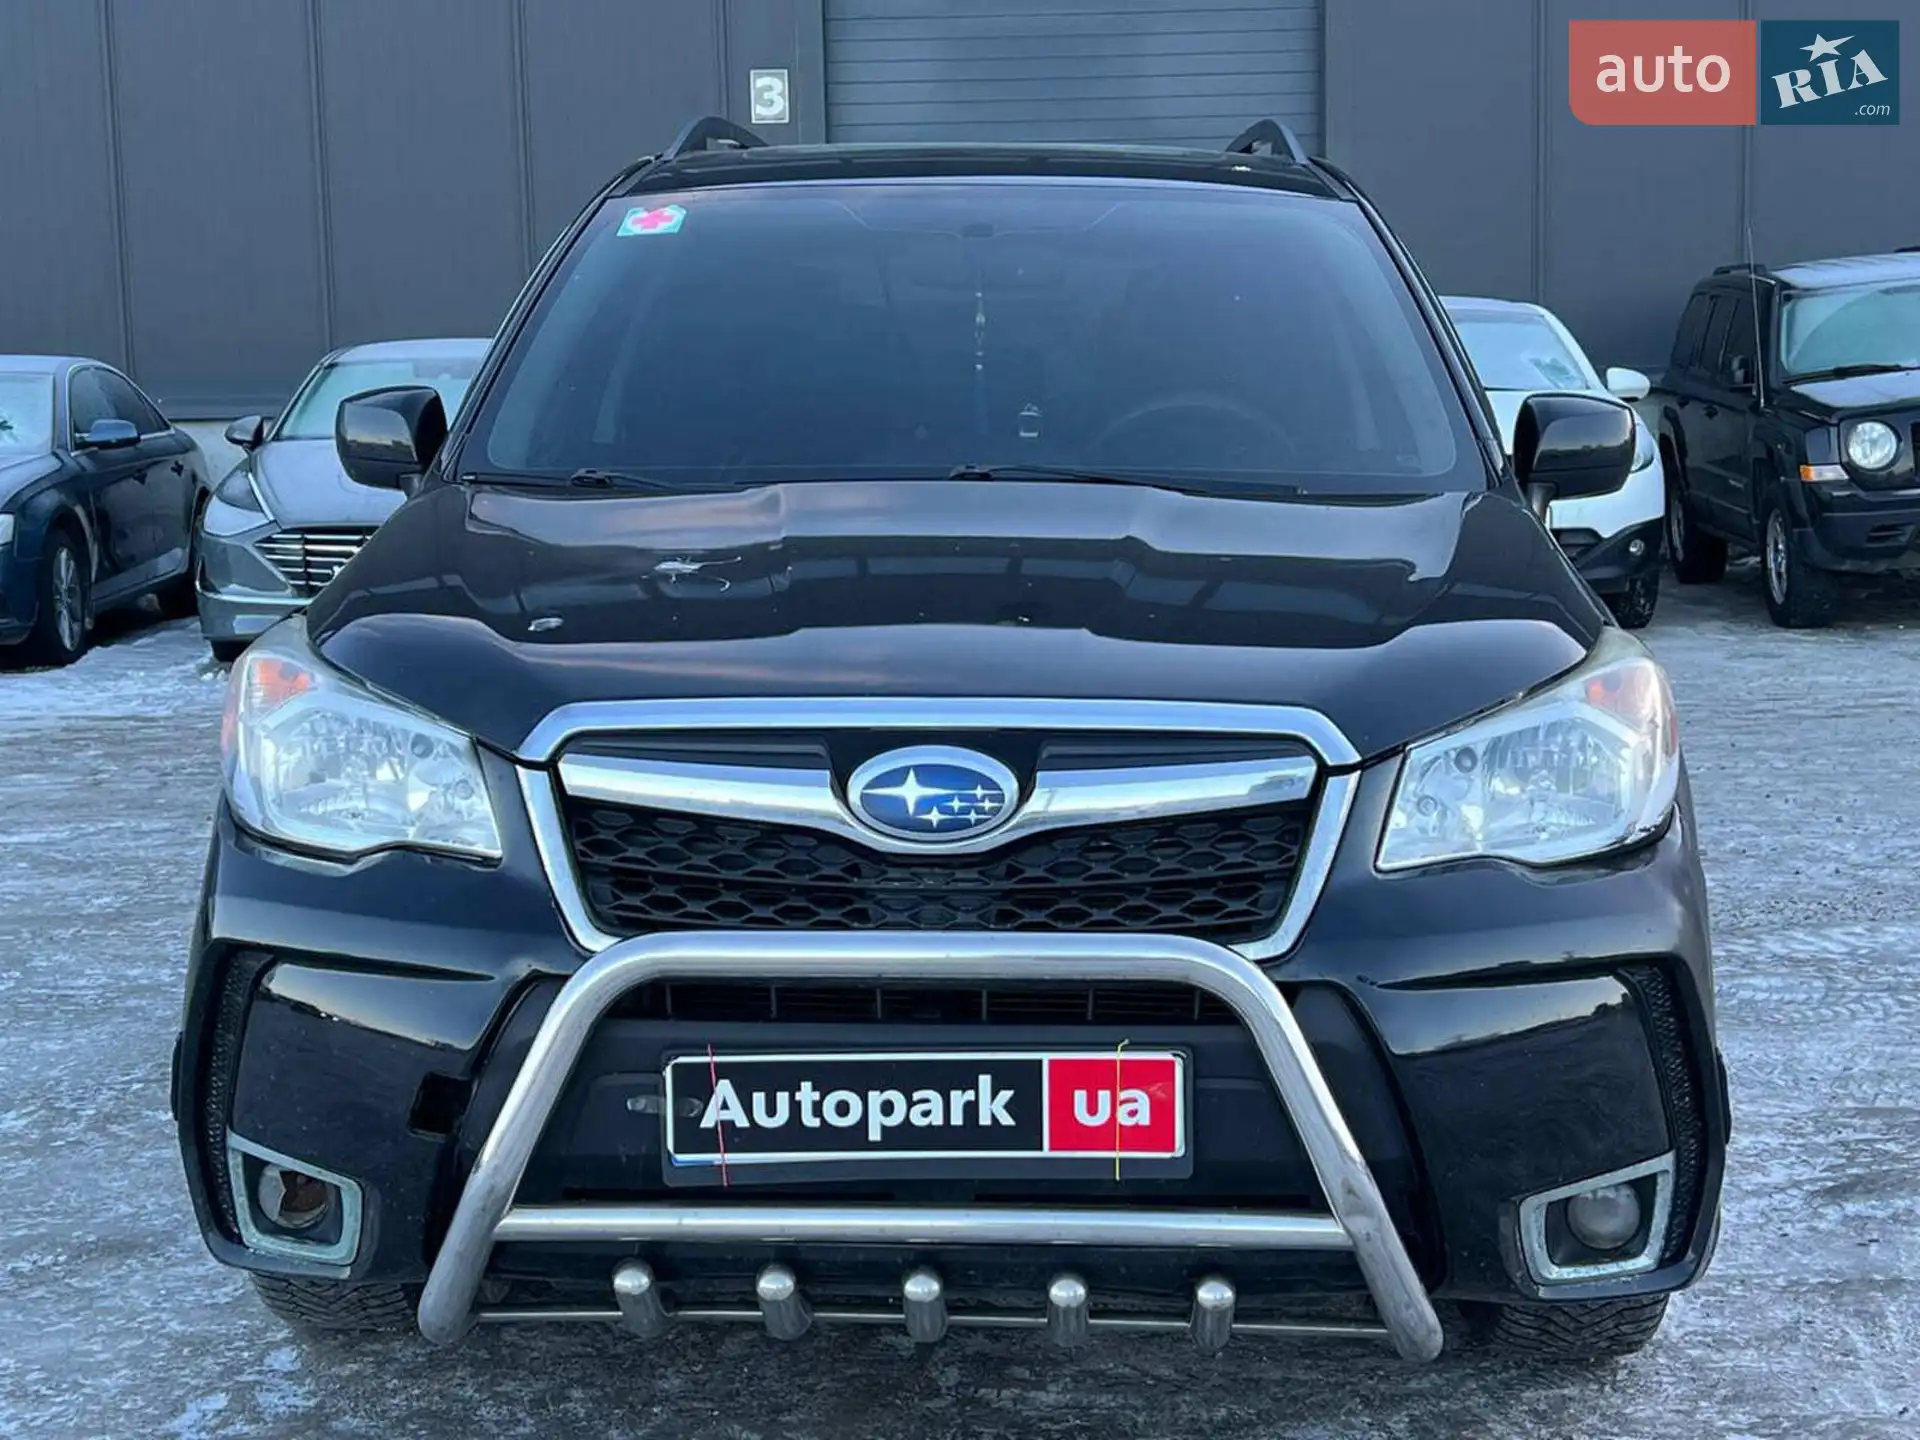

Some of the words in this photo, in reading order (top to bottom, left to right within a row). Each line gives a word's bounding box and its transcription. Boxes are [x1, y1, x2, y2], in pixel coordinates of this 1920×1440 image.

[755, 76, 783, 116] 3
[700, 1074, 1016, 1141] Autopark
[1073, 1088, 1152, 1126] ua
